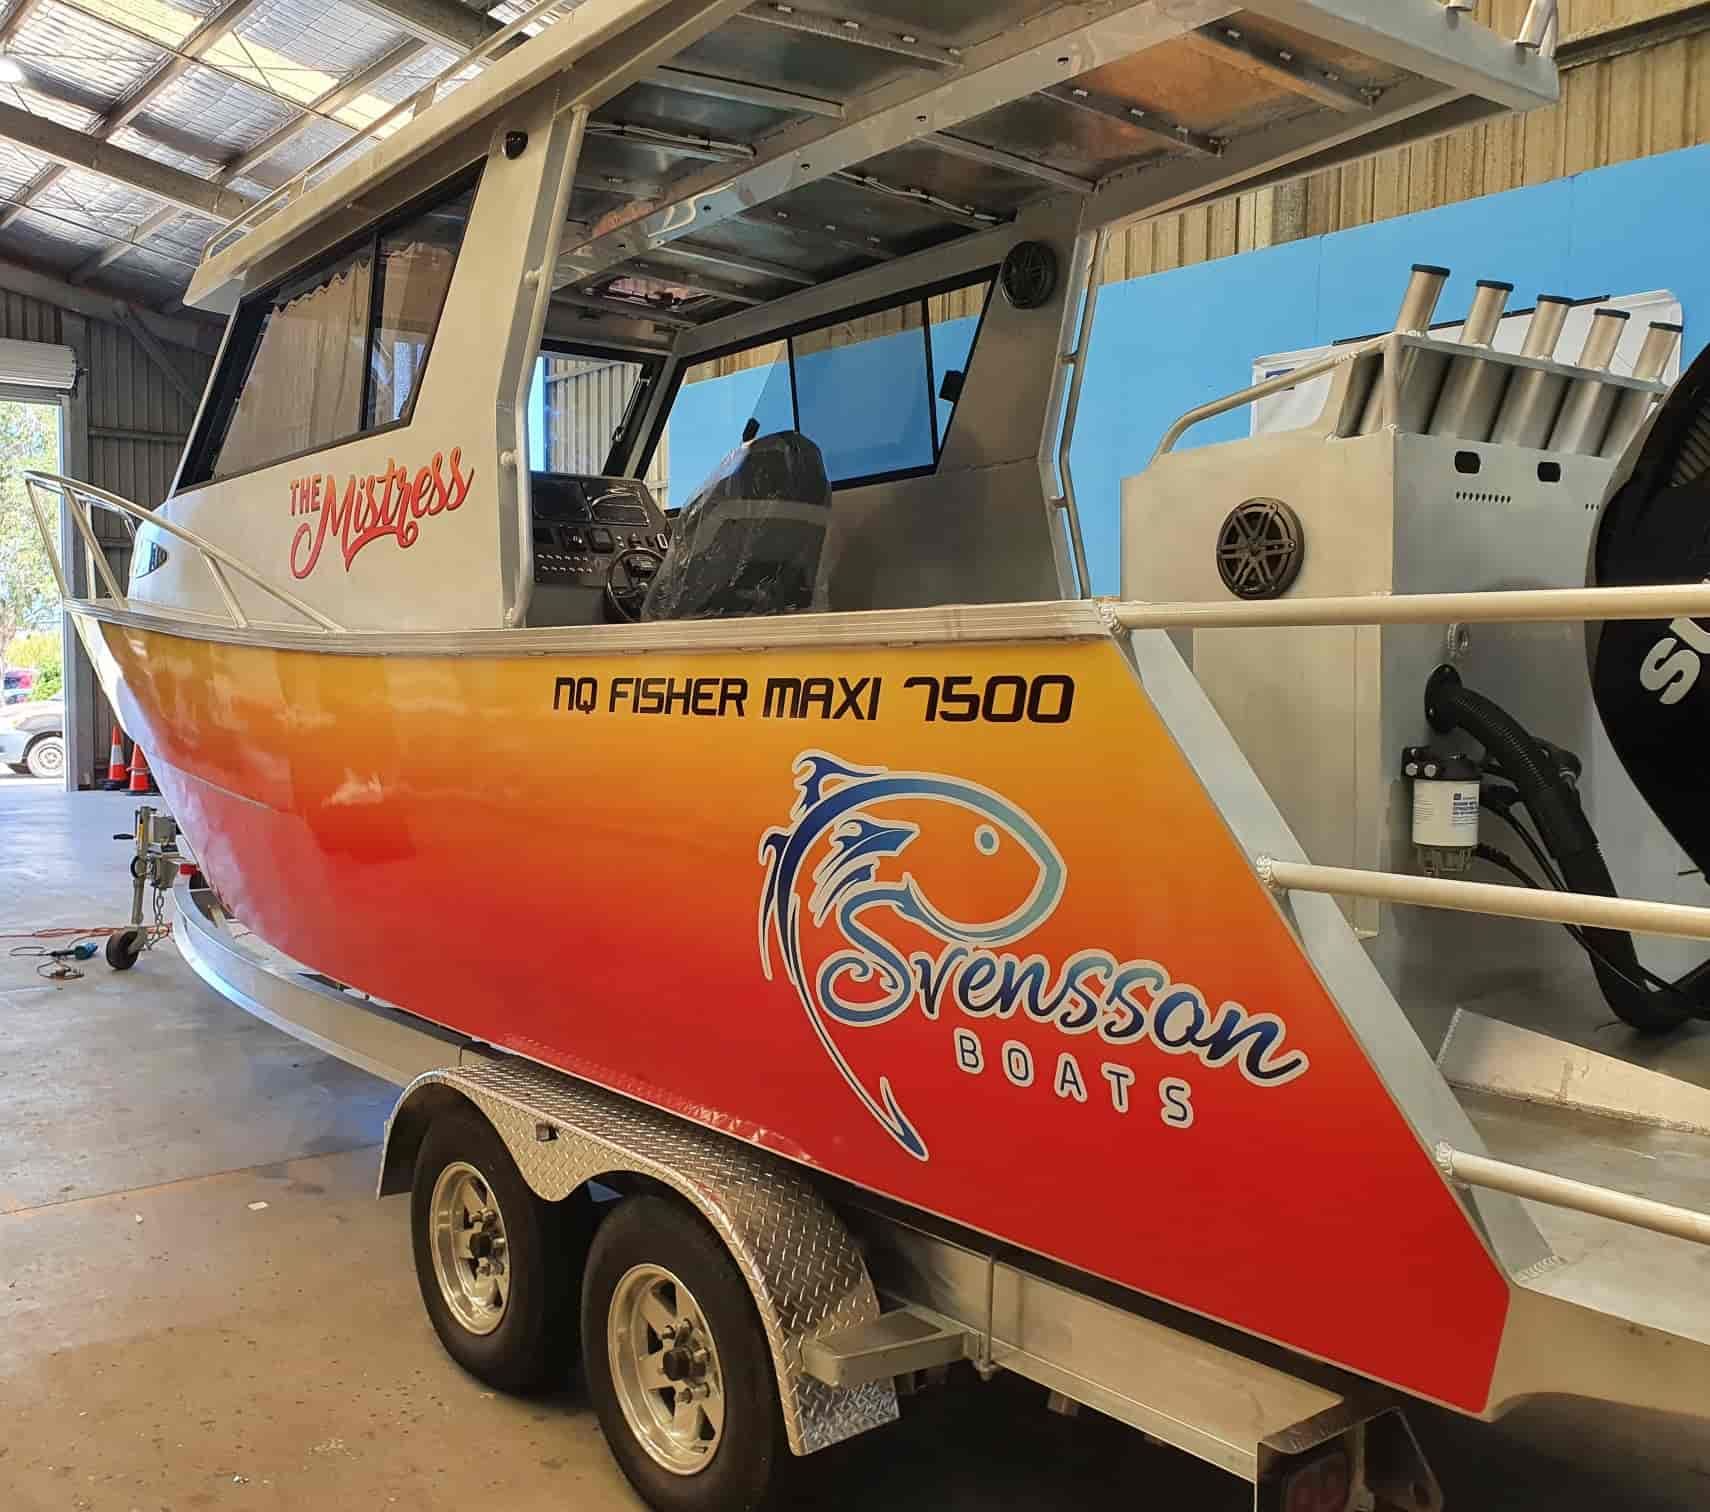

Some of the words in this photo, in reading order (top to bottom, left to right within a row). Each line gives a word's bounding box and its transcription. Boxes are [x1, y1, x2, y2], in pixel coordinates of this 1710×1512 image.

[290, 474, 322, 516] THE
[290, 447, 475, 579] Mistress
[609, 677, 747, 716] FISHER
[762, 677, 882, 721] MAXI
[903, 674, 1075, 724] 7500
[815, 884, 1310, 1087] Svensson
[953, 1027, 1194, 1129] BOATS
